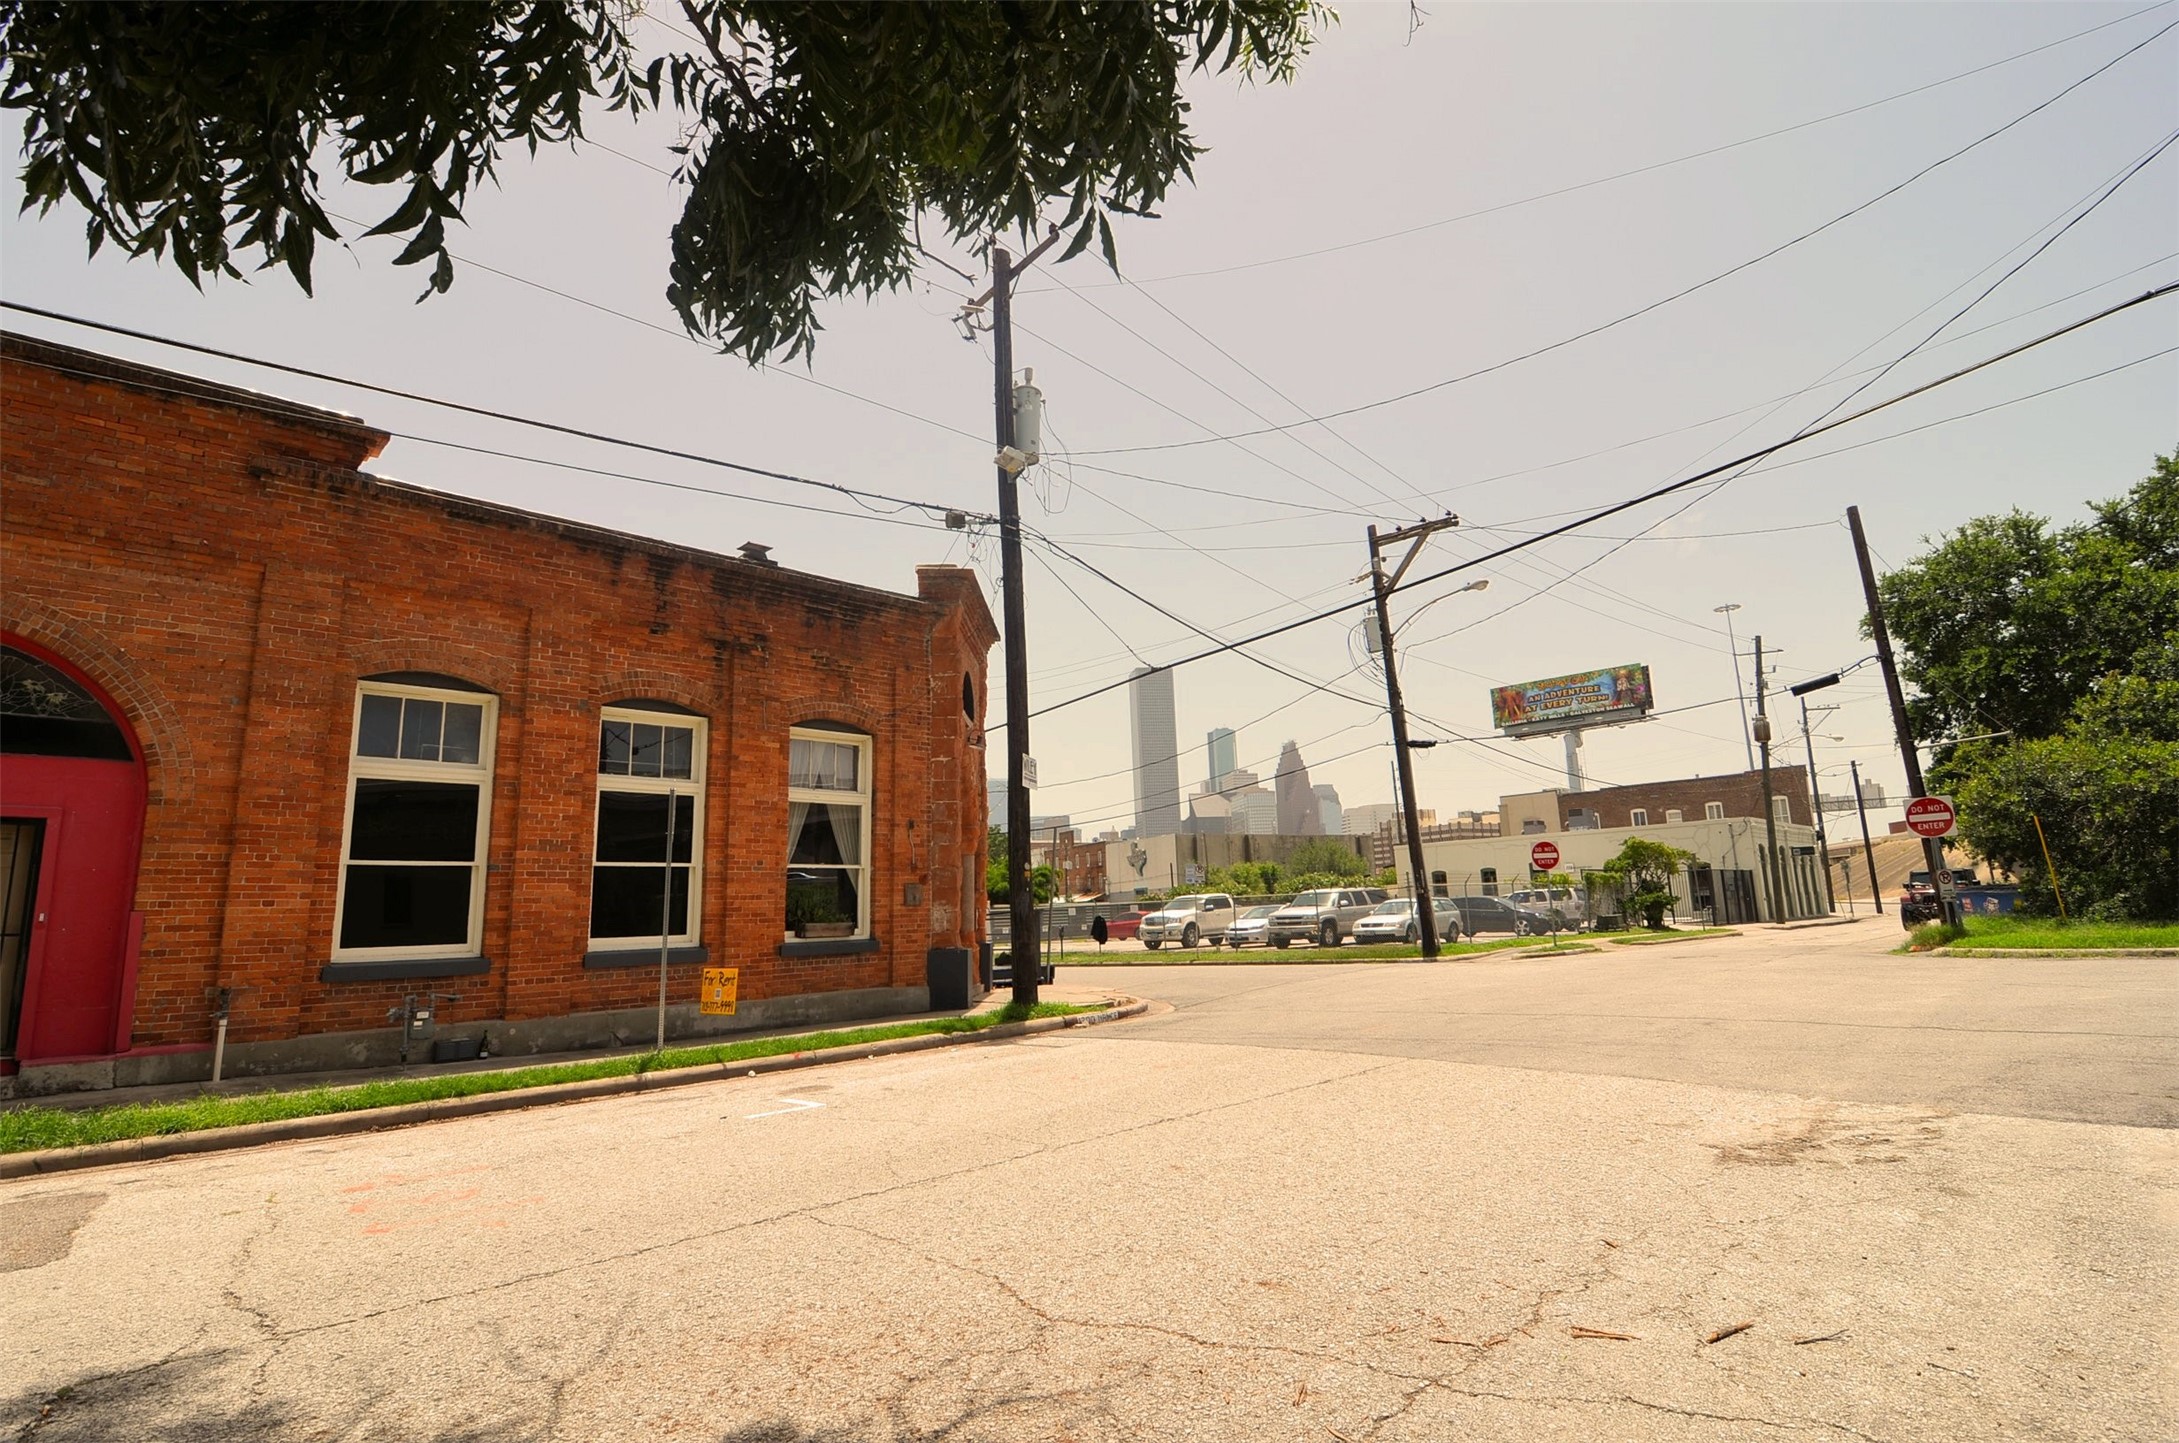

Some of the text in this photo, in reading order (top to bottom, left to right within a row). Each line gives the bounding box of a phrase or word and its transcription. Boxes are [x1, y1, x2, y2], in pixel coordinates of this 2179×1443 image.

[1528, 685, 1600, 703] AN ADVENTURE
[1525, 694, 1609, 713] AT EVERY TURN!
[1501, 718, 1527, 727] GALLERIA
[1570, 706, 1605, 716] GALVESTON
[1606, 702, 1635, 711] SEAWALL
[1911, 804, 1945, 814] DO NOT
[1917, 821, 1945, 830] ENTER
[704, 970, 736, 987] For Rent
